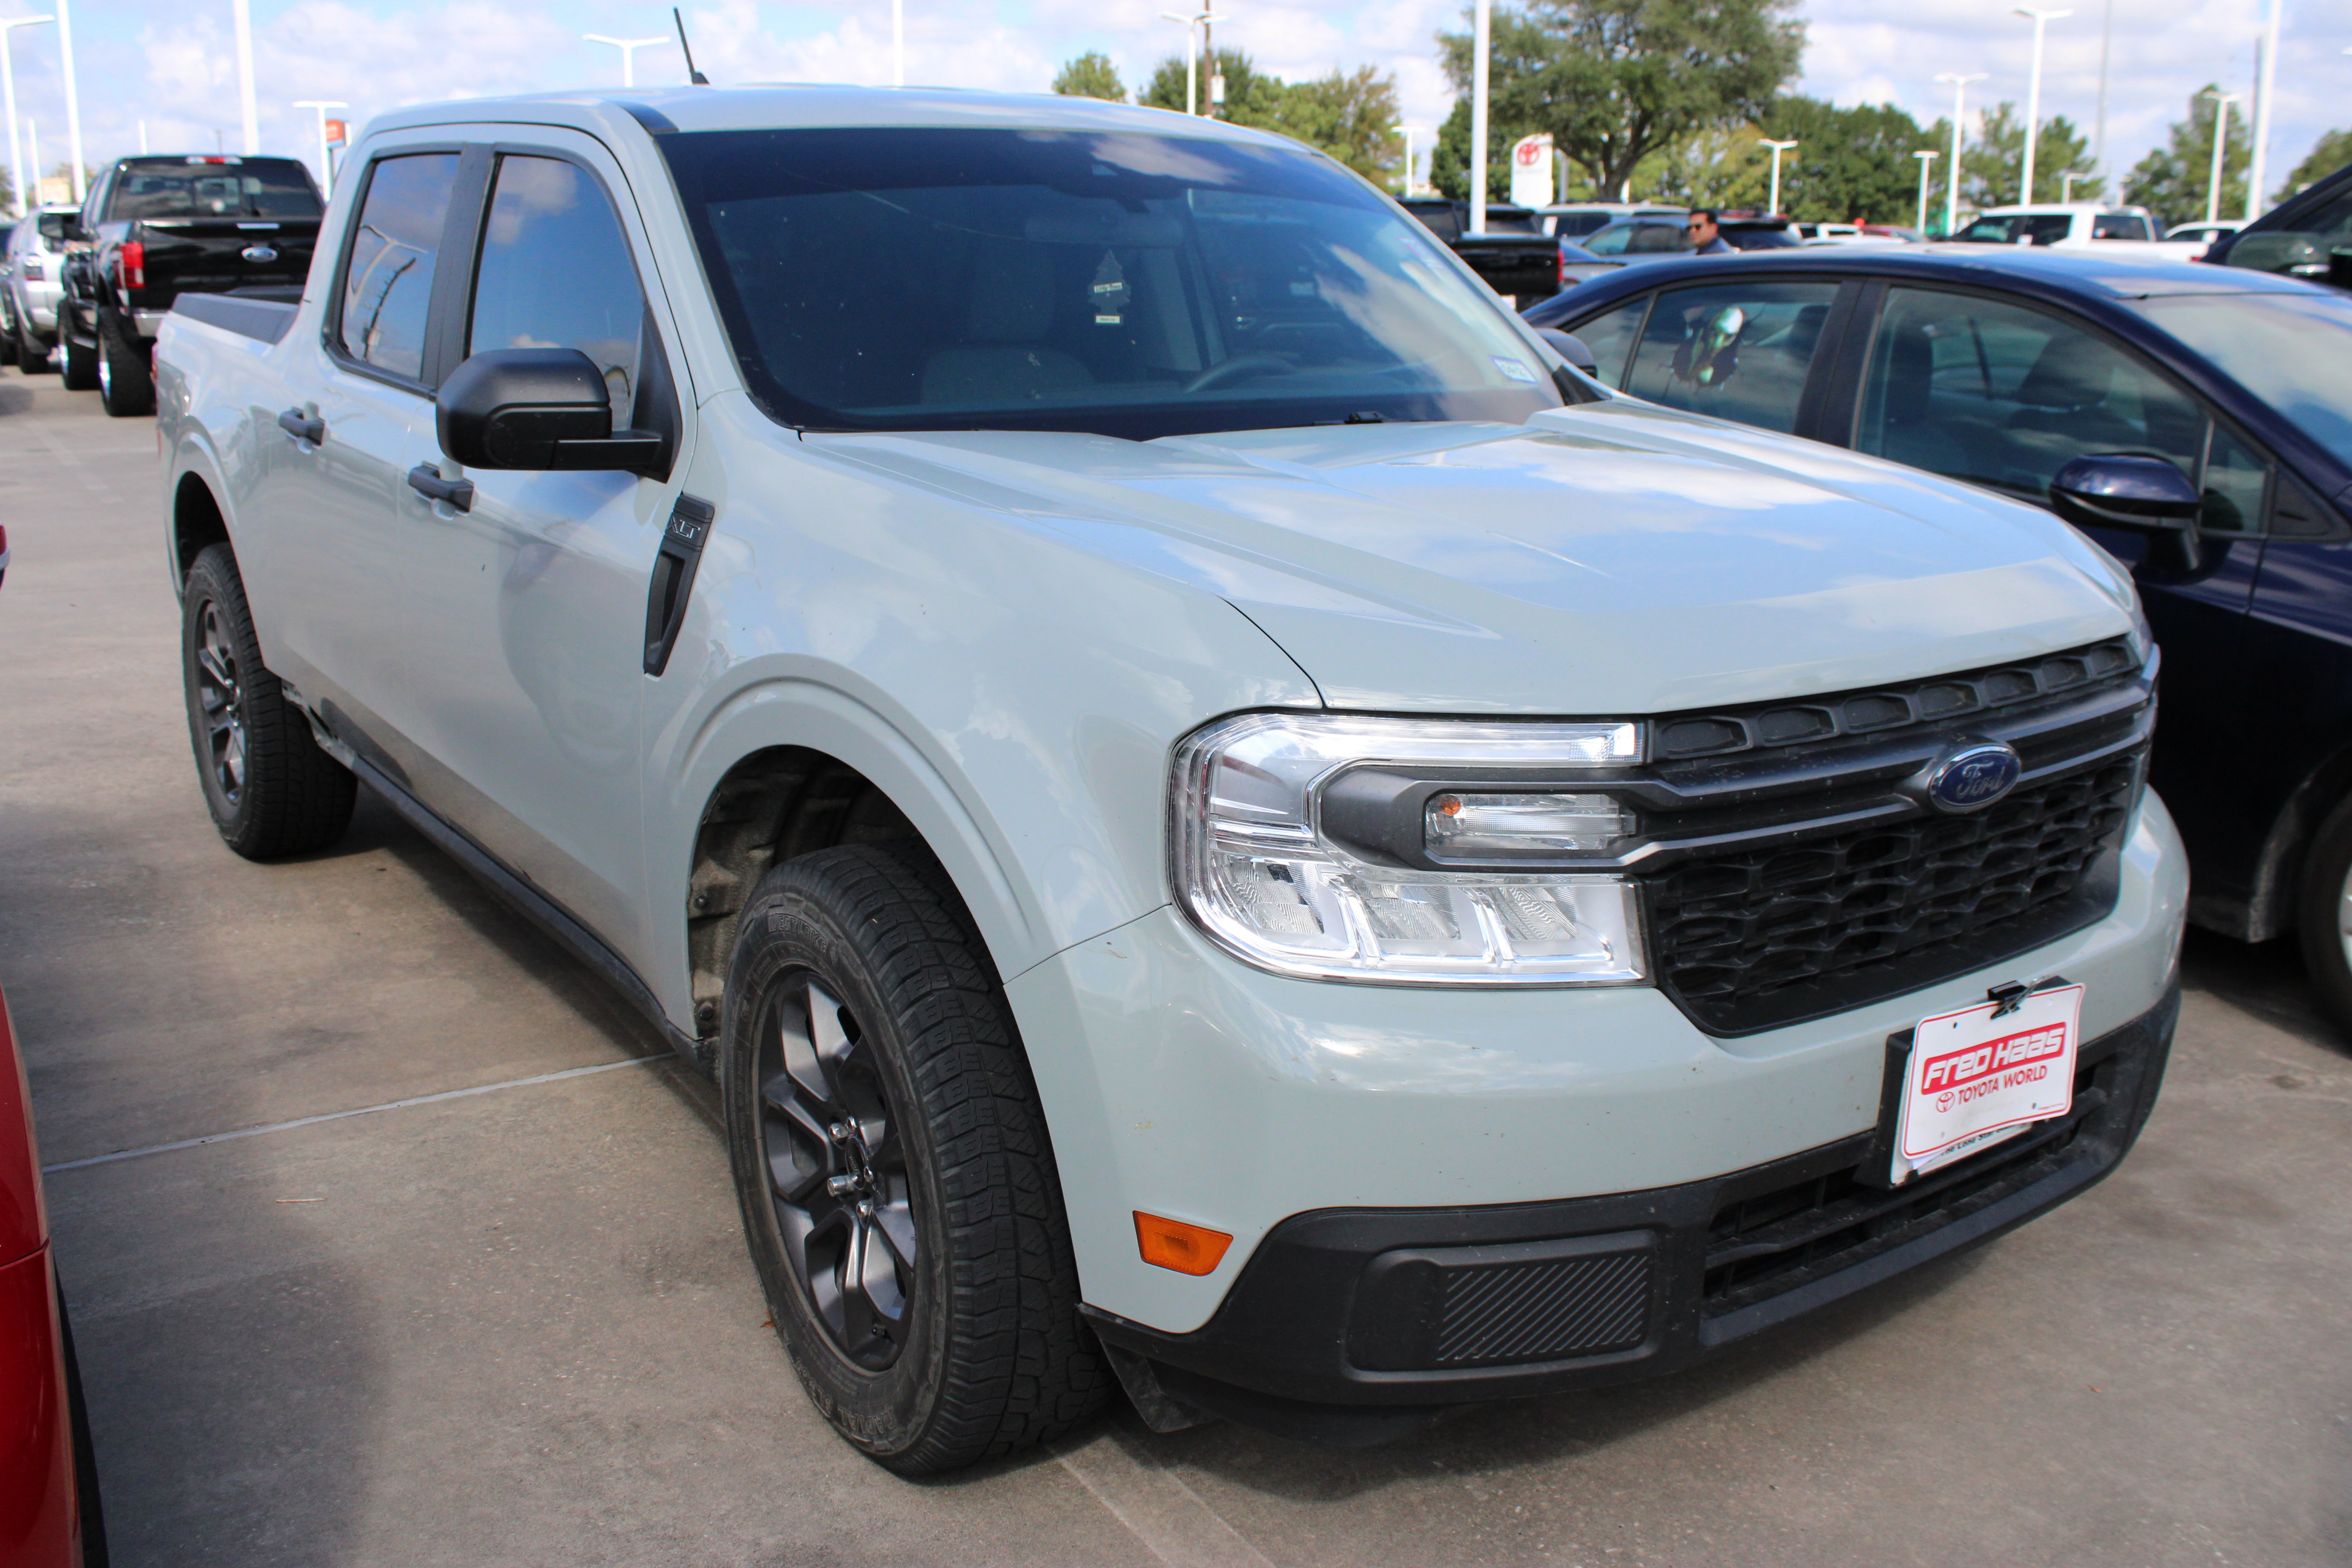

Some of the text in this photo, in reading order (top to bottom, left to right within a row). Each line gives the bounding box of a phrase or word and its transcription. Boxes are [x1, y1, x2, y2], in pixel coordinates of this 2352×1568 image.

[666, 515, 701, 539] XLT
[1956, 761, 2007, 799] Ford
[767, 913, 829, 953] WESTLAKE
[1958, 1065, 2047, 1105] TOYOTA WORLD
[1957, 1137, 1976, 1149] Lone
[838, 1405, 897, 1435] RADIAL
